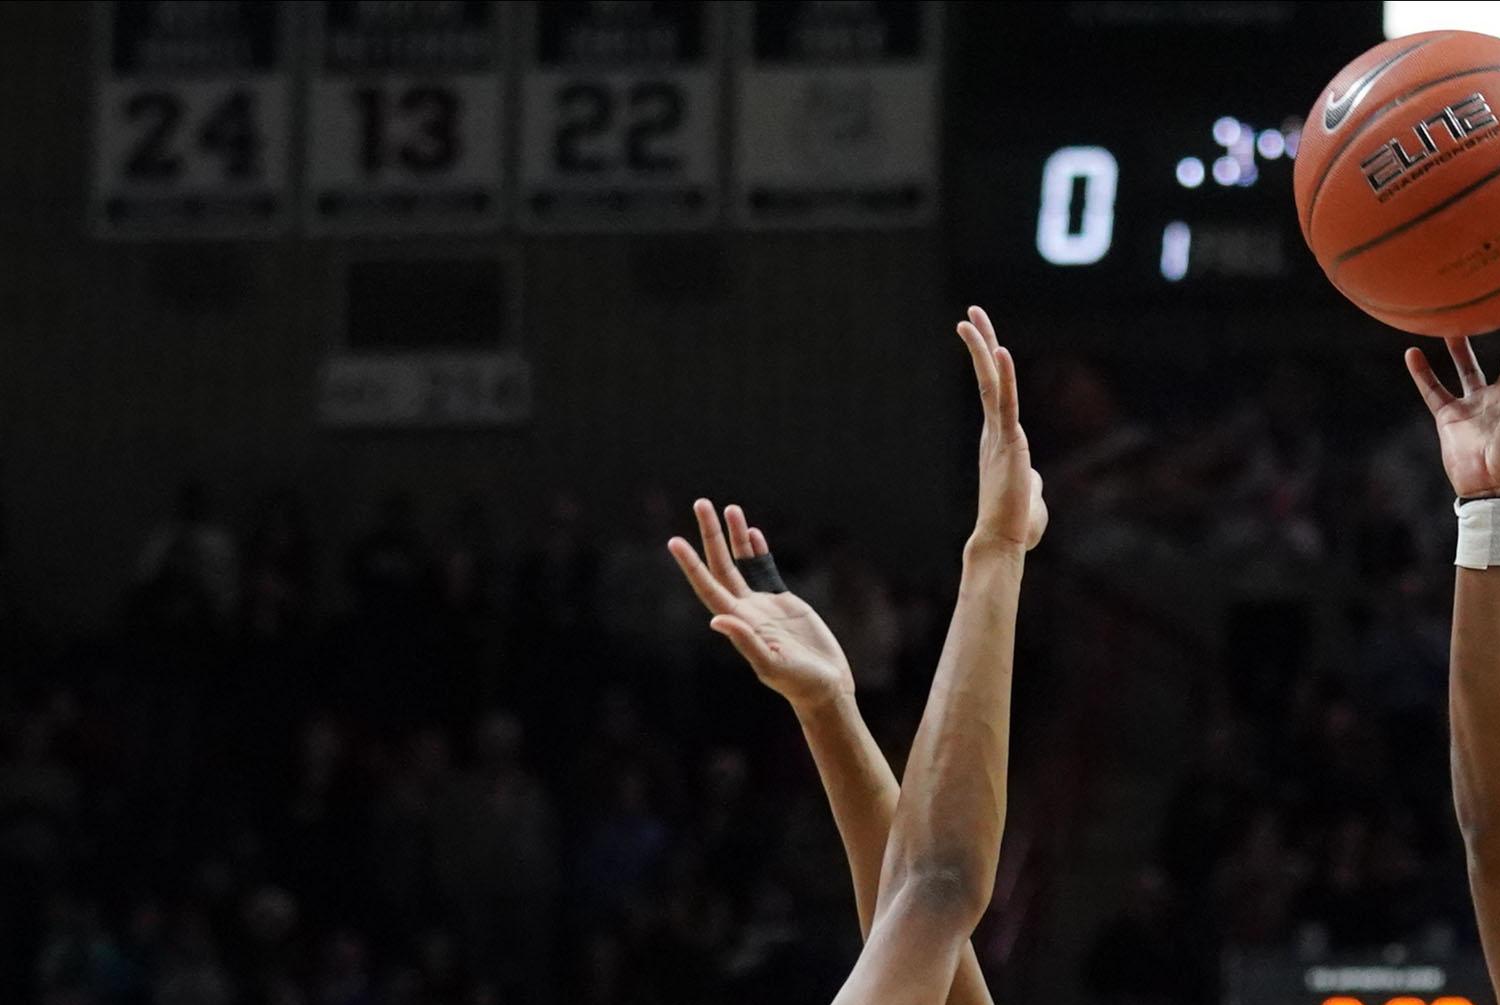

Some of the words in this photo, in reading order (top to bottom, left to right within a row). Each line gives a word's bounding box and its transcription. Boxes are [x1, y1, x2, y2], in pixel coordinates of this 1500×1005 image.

[357, 86, 458, 173] 13
[556, 81, 684, 172] 22
[1360, 92, 1499, 192] ELITE
[1036, 145, 1119, 266] 0
[1161, 220, 1191, 282] 1
